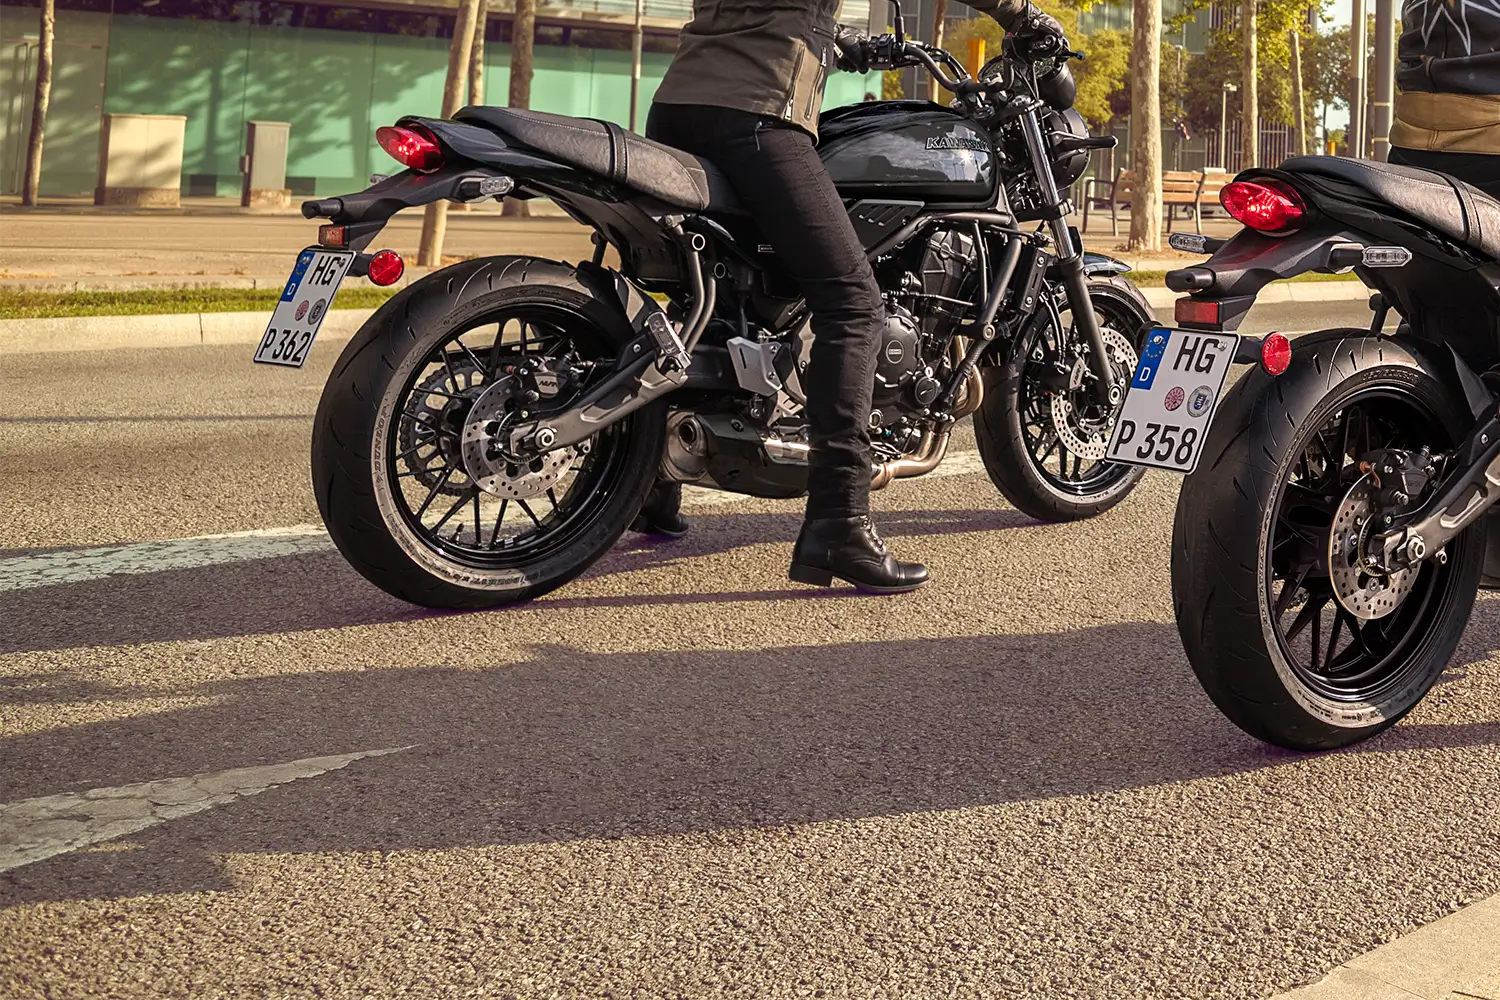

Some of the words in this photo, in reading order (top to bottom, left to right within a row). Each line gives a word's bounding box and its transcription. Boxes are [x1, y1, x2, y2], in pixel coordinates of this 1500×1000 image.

[308, 256, 341, 286] HG
[287, 283, 297, 296] D
[259, 328, 277, 358] P
[272, 330, 311, 362] 362
[1173, 336, 1219, 373] HG
[1139, 367, 1150, 381] D
[1113, 420, 1136, 455] P
[1136, 423, 1197, 465] 358
